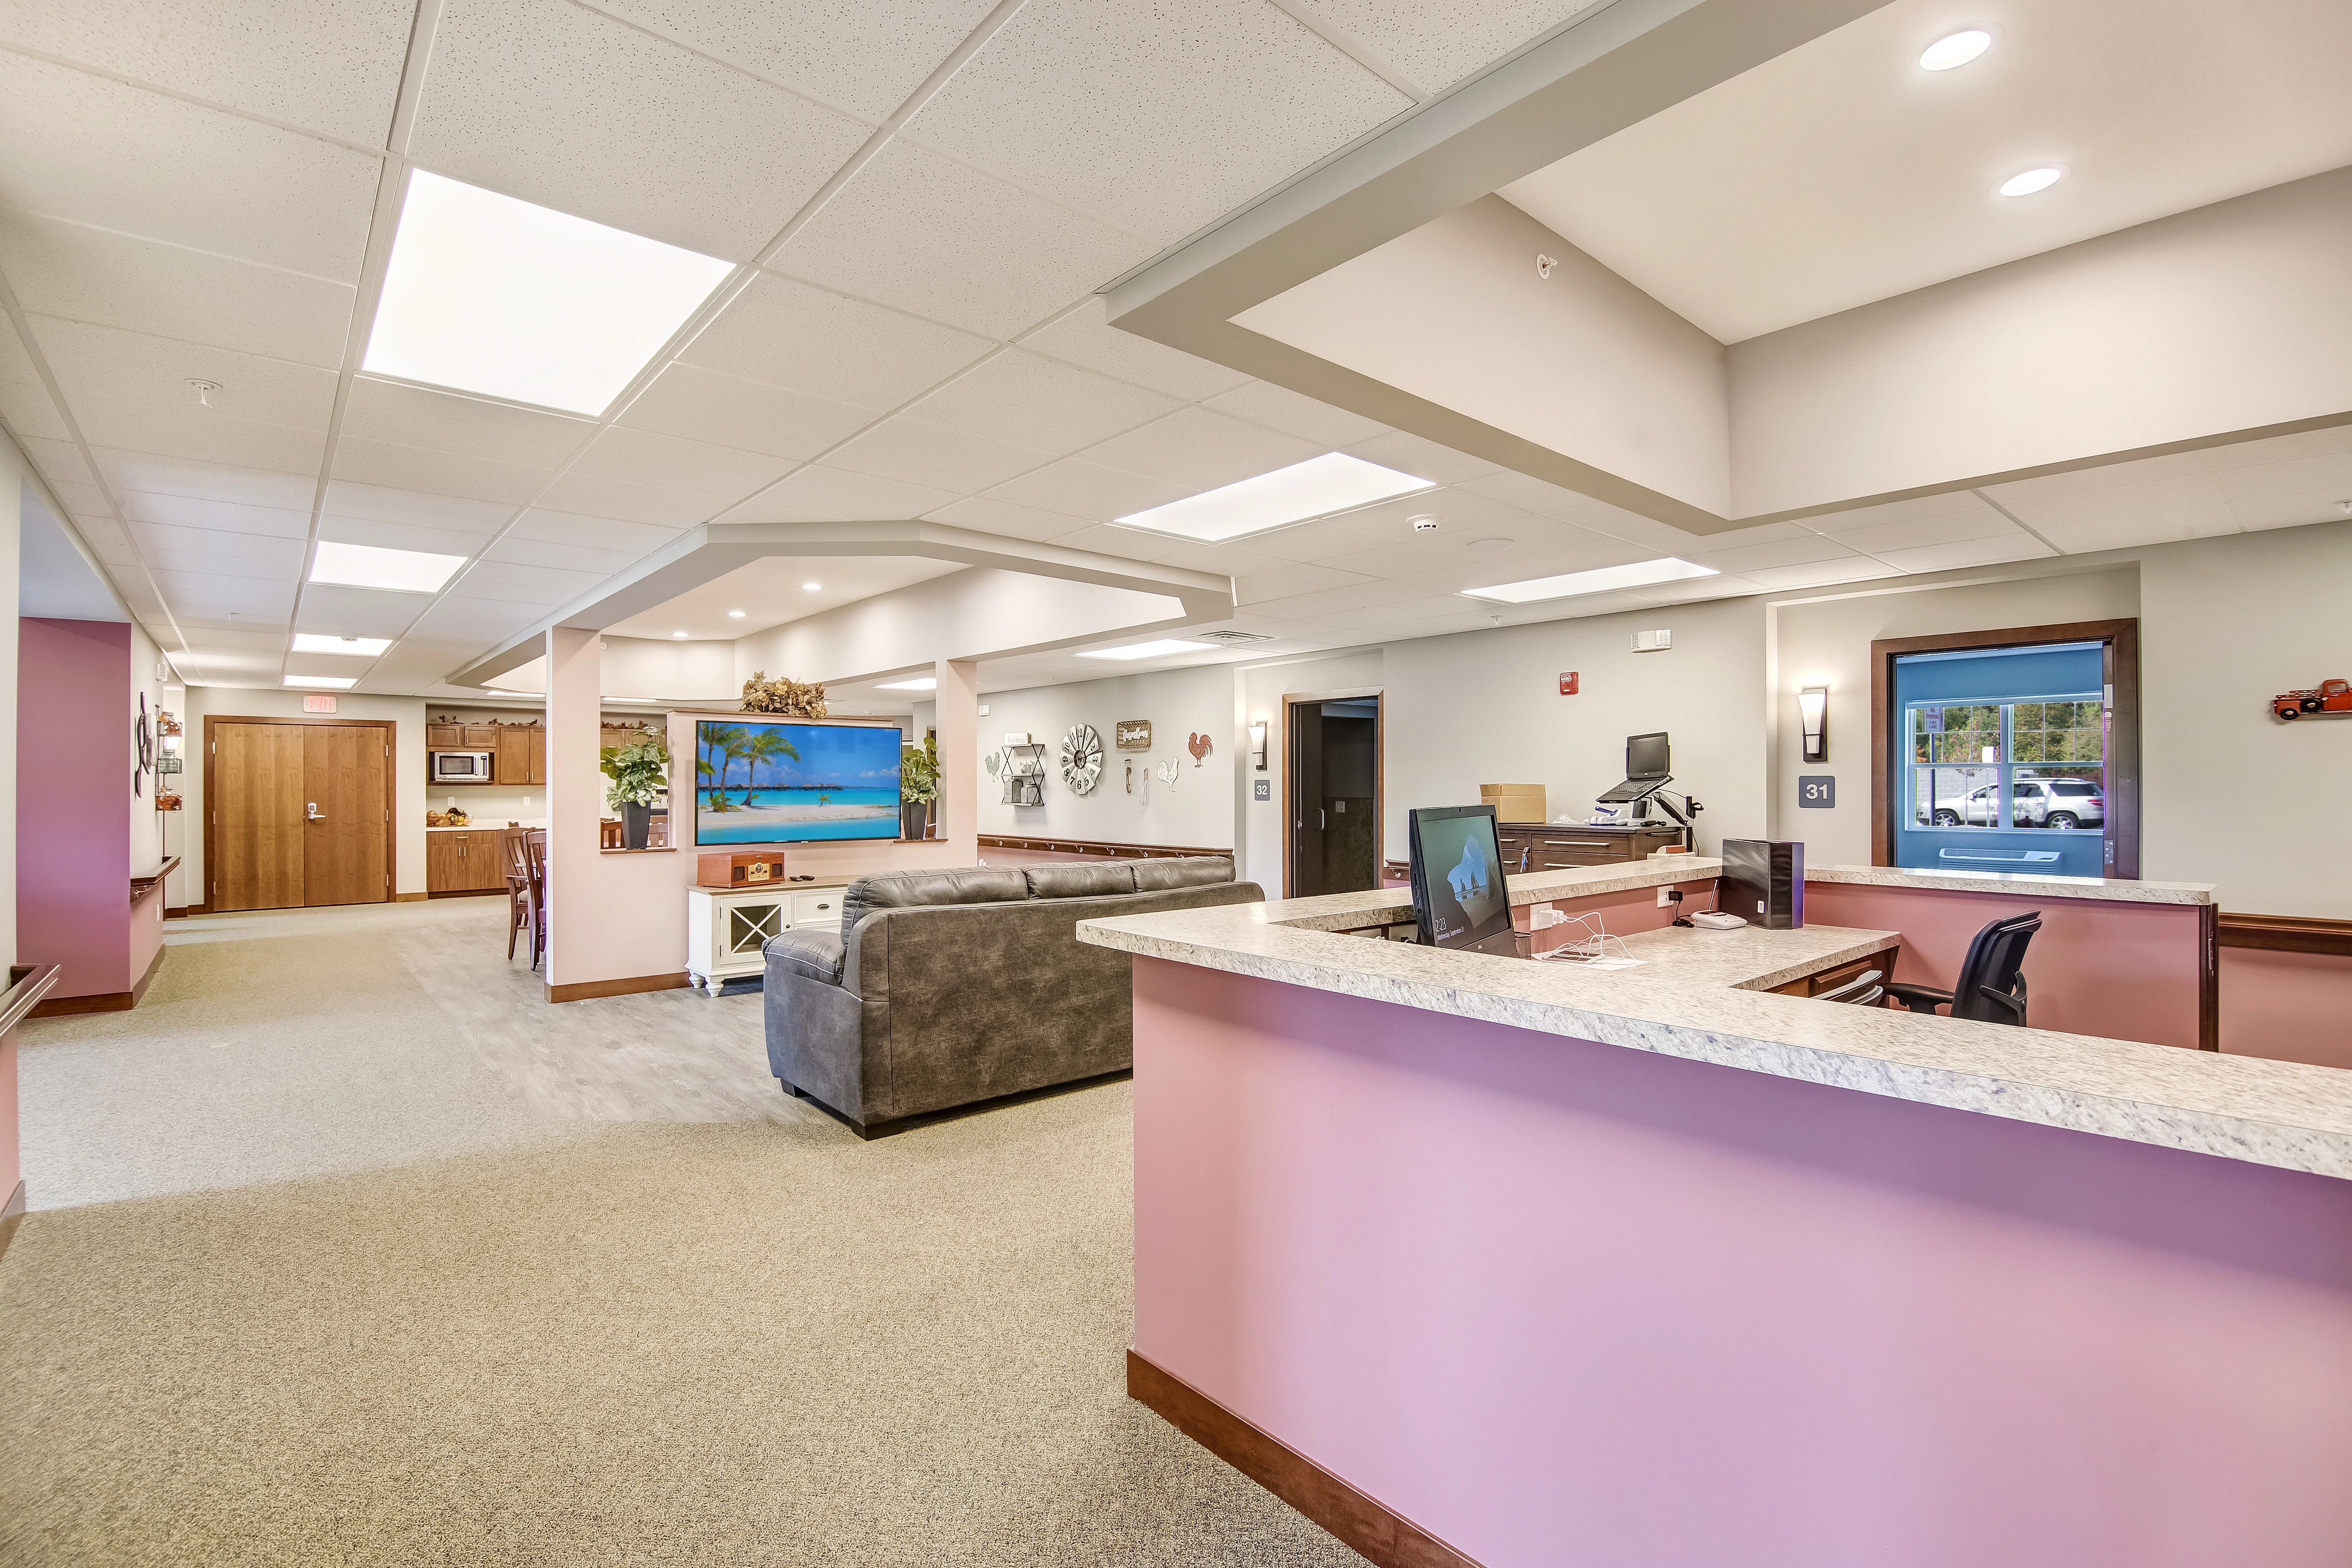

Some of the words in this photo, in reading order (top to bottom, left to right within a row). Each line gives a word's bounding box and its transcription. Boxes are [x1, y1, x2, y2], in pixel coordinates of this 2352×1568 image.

[308, 696, 333, 711] EXIT
[1070, 732, 1076, 743] 11
[1078, 729, 1082, 738] 12
[1086, 732, 1089, 741] 1
[1064, 742, 1070, 752] 10
[1090, 742, 1096, 751] 2
[1064, 768, 1070, 777] 8
[1070, 776, 1075, 785] 7
[1077, 780, 1081, 790] 6
[1084, 776, 1089, 786] 5
[1256, 785, 1268, 795] 32
[1806, 784, 1828, 799] 31
[1435, 917, 1446, 932] 2:23
